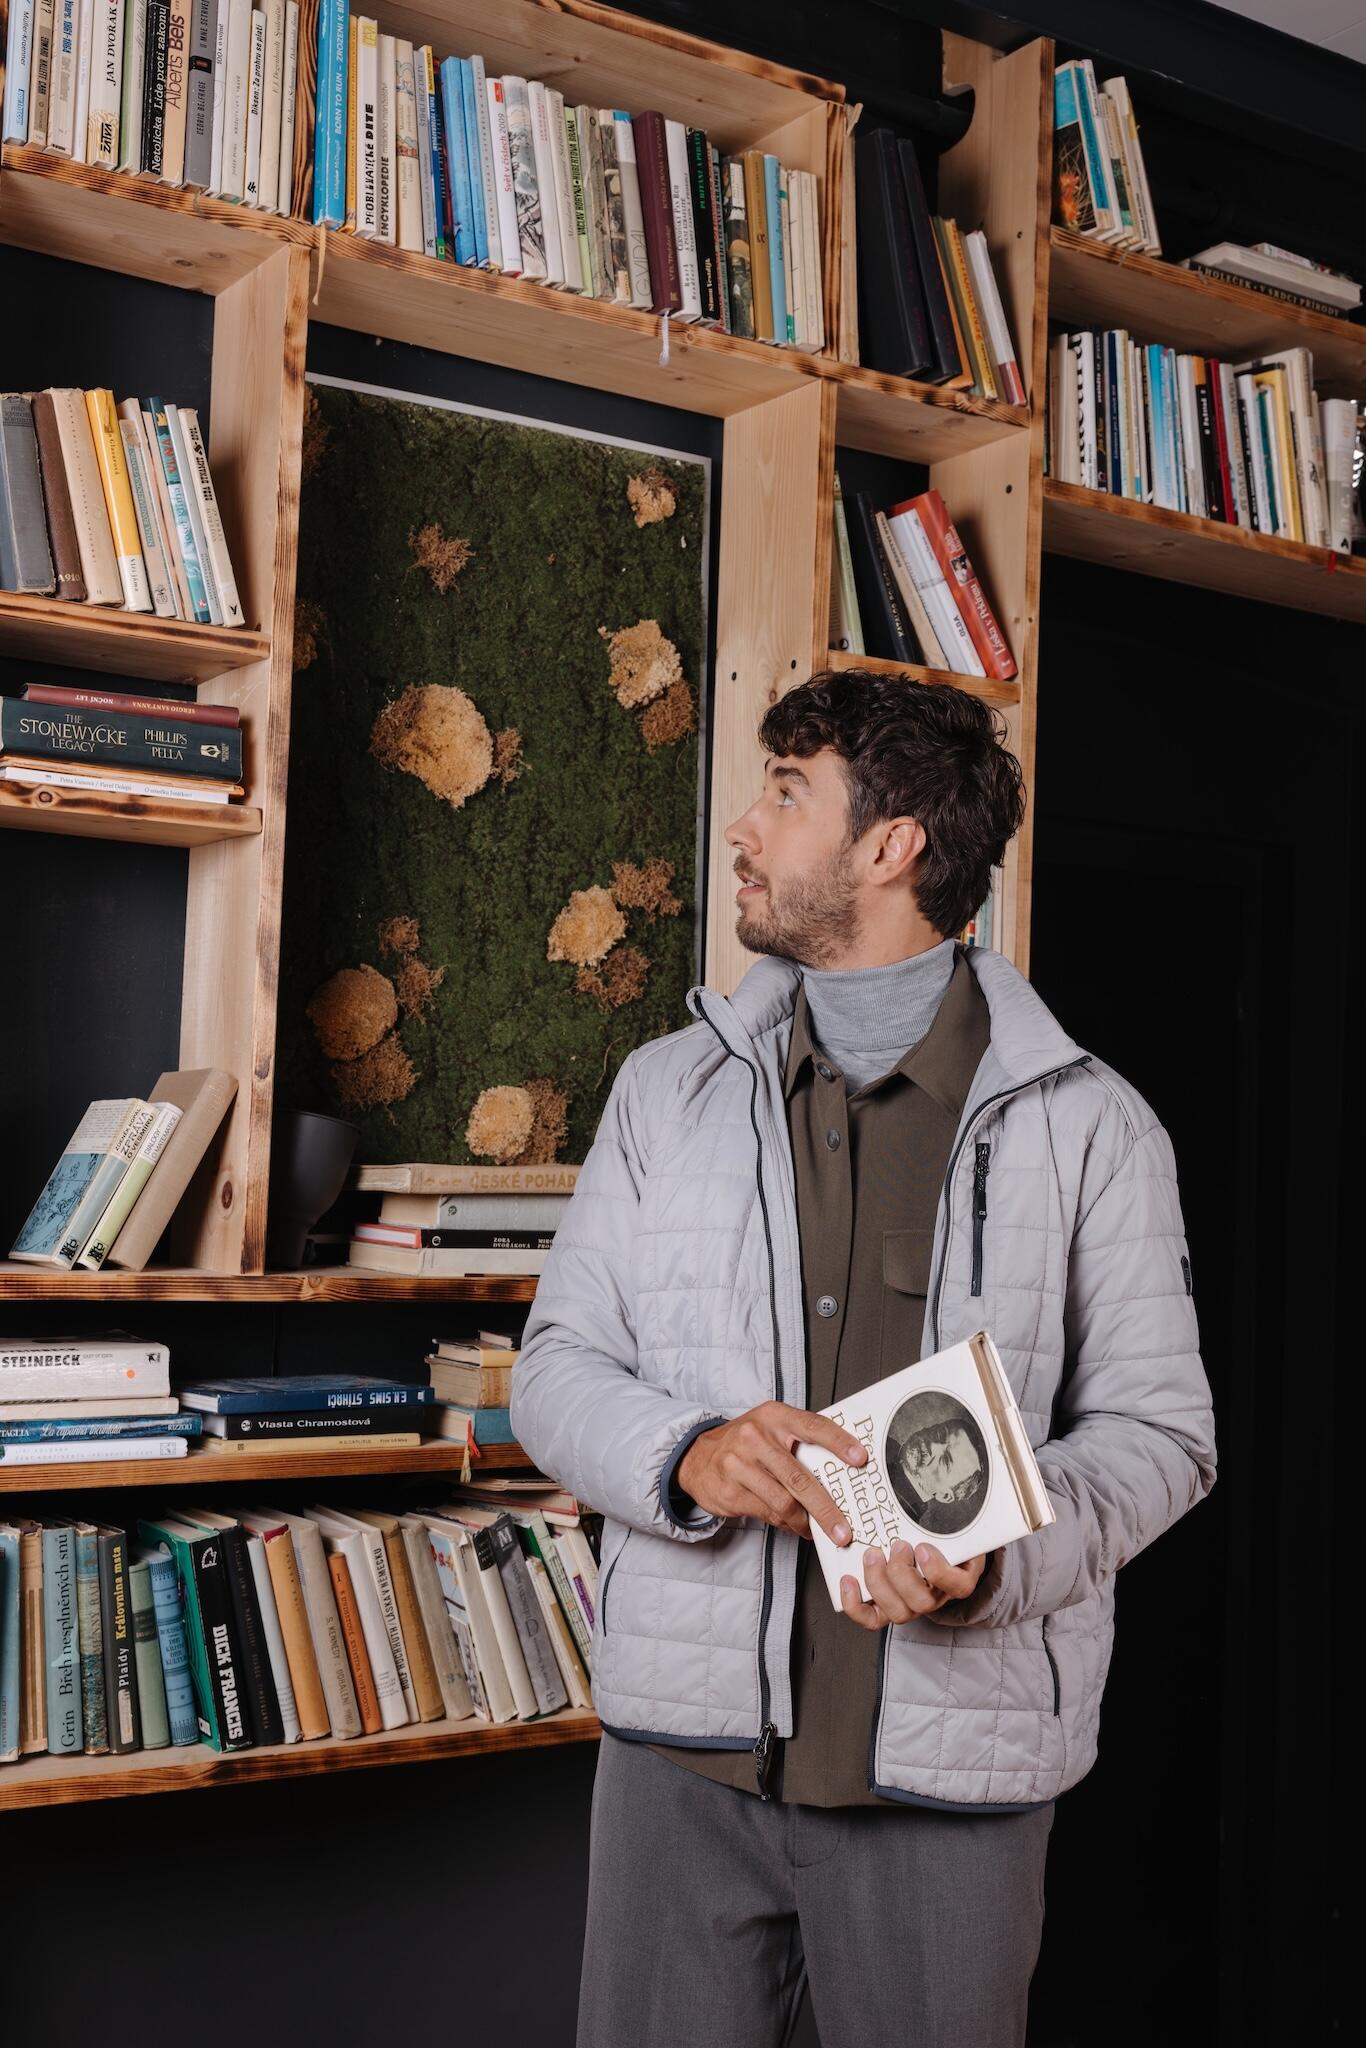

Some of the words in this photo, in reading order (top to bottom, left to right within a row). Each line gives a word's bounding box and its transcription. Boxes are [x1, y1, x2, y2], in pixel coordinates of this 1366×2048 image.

[62, 21, 73, 54] 1861-1864
[106, 7, 117, 57] DVOŘÁK
[168, 14, 185, 51] Bels
[39, 36, 49, 57] EDWARD
[107, 62, 117, 86] JAN
[154, 51, 167, 83] proti
[253, 53, 263, 77] prohru
[37, 80, 47, 95] CARR
[166, 56, 183, 109] Alberts
[251, 77, 260, 87] Za
[335, 72, 343, 93] RUN
[196, 80, 206, 112] BELFRAGE
[335, 94, 343, 107] TO
[196, 113, 206, 135] CEDRIC
[334, 107, 343, 135] BORN
[497, 113, 507, 134] 2009
[500, 135, 510, 165] číslech
[502, 172, 512, 192] Svět
[380, 156, 389, 237] ENCYKLOPEDIE
[705, 288, 714, 312] Simon
[57, 572, 80, 582] A910
[74, 694, 88, 702] LET
[89, 695, 114, 704] NOČNÍ
[19, 718, 128, 746] STONEWYCKE
[64, 713, 83, 725] THE
[52, 738, 95, 753] LEGACY
[144, 728, 188, 745] PHILLIPS
[152, 746, 184, 761] PELLA
[115, 1124, 129, 1152] ZDENĚK
[128, 1107, 142, 1129] KOPAL
[120, 1111, 150, 1156] ZPRÁVA
[130, 1114, 154, 1152] VESMÍRU
[143, 1129, 161, 1156] DIALOGY
[155, 1114, 178, 1155] MATEMATICE
[127, 1151, 134, 1159] O
[471, 1172, 521, 1190] ČESKÉ
[525, 1173, 576, 1189] POHÁD
[2, 1353, 81, 1368] STEINBECK
[327, 1392, 363, 1408] STÍHAČI
[369, 1391, 392, 1404] SIMS
[168, 1423, 193, 1431] RIZZOLI
[258, 1420, 294, 1429] Vlasta
[297, 1417, 371, 1427] Chramostová
[853, 1414, 901, 1547] Přemožite
[59, 1533, 69, 1560] snů
[114, 1545, 122, 1574] msta
[373, 1547, 388, 1587] NĚMECKU
[57, 1562, 76, 1655] nesplněných
[115, 1574, 129, 1641] Královnina
[383, 1595, 395, 1621] LÁSKA
[213, 1623, 233, 1667] DICK
[328, 1626, 340, 1659] KENNEDY
[389, 1627, 404, 1669] HOCHHUTH
[59, 1657, 75, 1696] Břeh
[118, 1647, 131, 1688] Plaidy
[220, 1668, 245, 1740] FRANCIS
[61, 1709, 76, 1747] Grin
